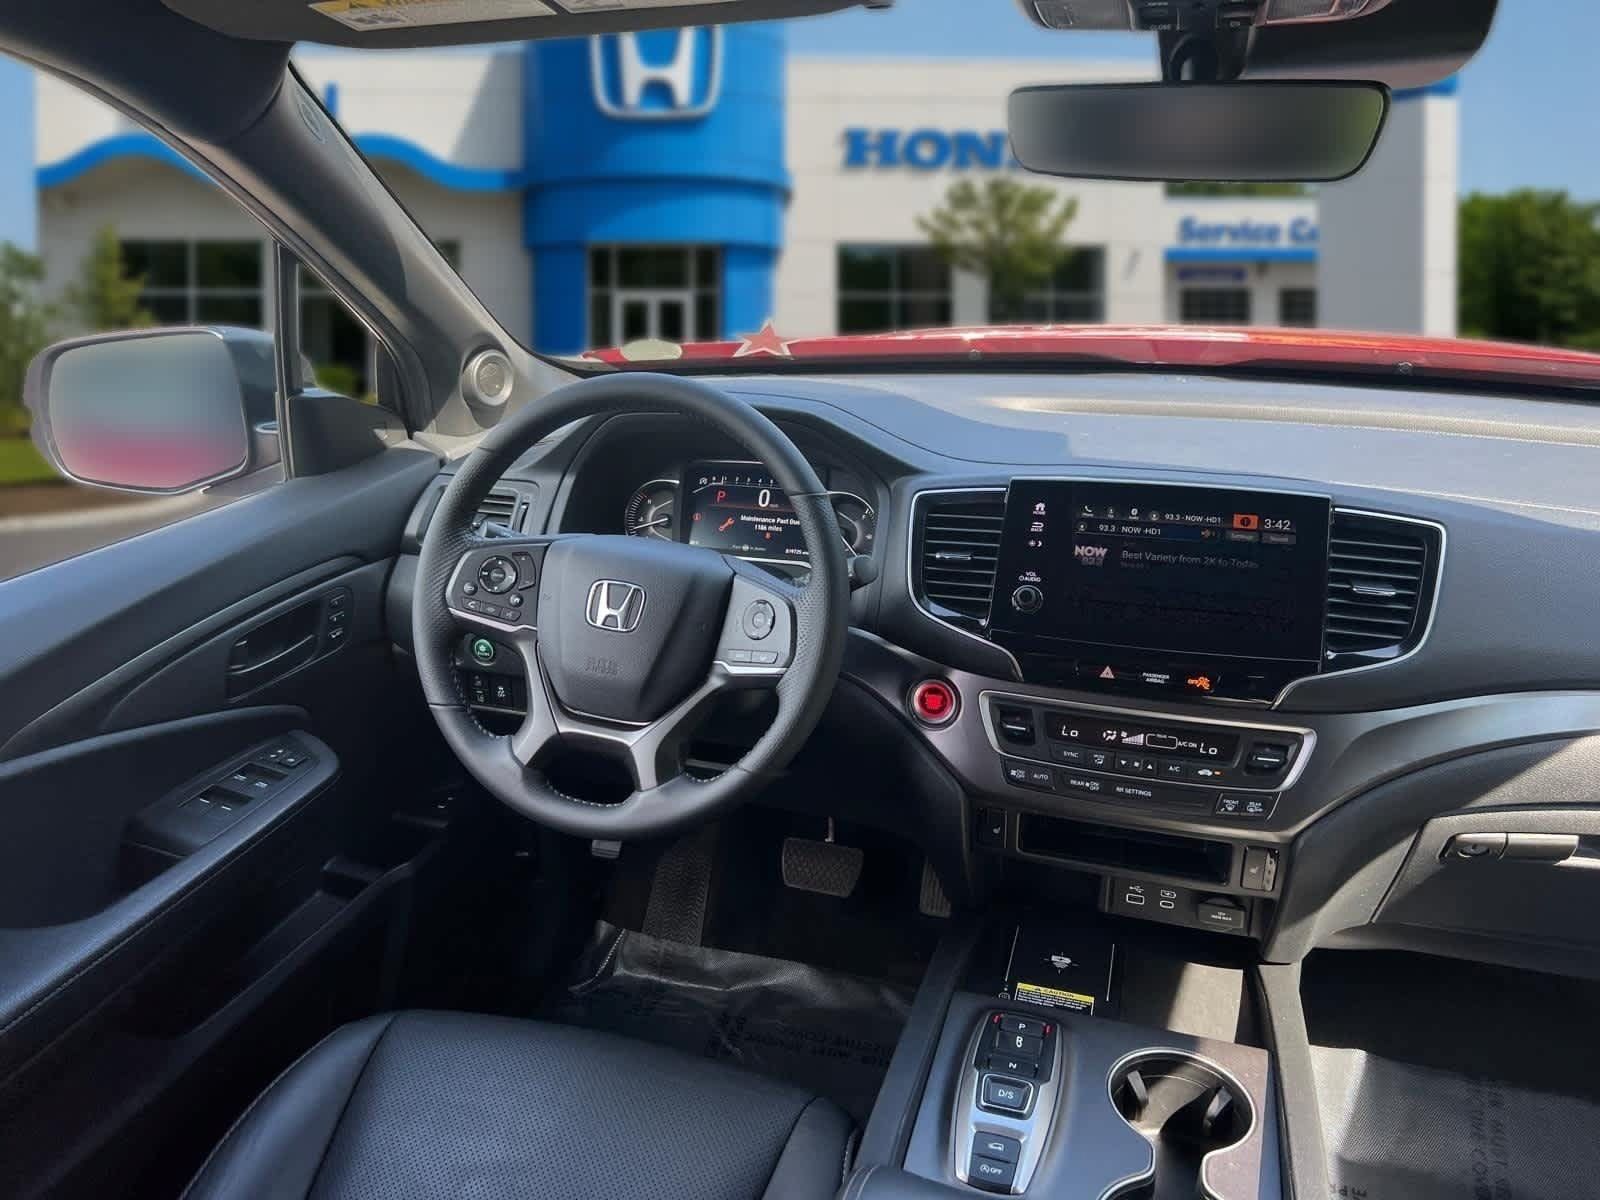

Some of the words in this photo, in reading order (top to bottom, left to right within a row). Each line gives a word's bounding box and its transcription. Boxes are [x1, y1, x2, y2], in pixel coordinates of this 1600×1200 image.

[842, 126, 1018, 172] HON
[717, 490, 727, 503] P
[758, 489, 770, 507] 0
[740, 515, 776, 524] Maintenance
[1264, 518, 1290, 530] 3:42
[1098, 524, 1116, 532] 93.3
[1074, 546, 1108, 557] NOW
[1122, 550, 1143, 560] Best
[1145, 552, 1178, 563] Variety
[1179, 554, 1200, 564] from
[1062, 725, 1079, 737] Lo
[1200, 742, 1218, 755] Lo
[1125, 788, 1152, 797] SETTINGS
[998, 1090, 1014, 1099] D/S
